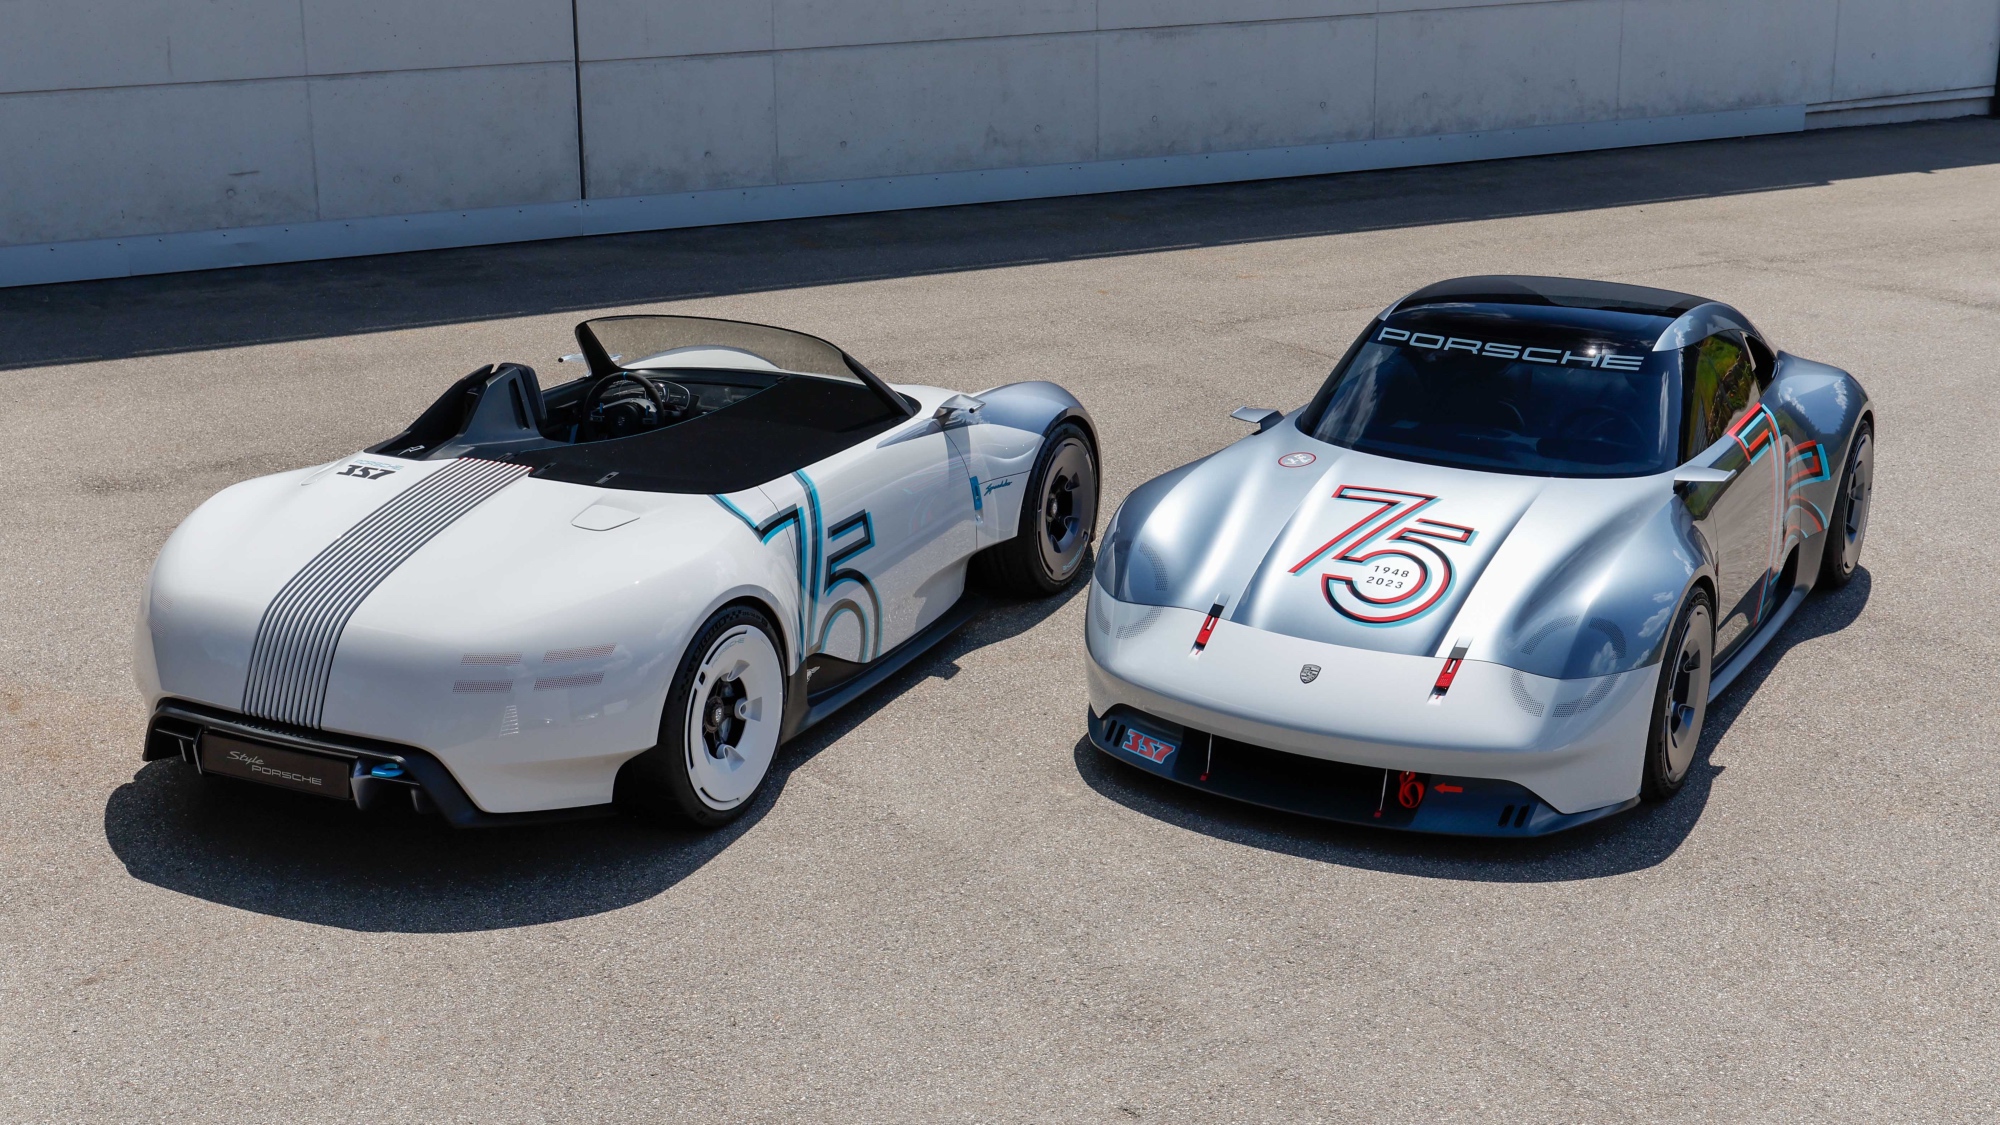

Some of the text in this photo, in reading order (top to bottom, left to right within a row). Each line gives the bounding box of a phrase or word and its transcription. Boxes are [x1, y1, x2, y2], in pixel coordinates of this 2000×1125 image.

[1378, 327, 1644, 371] PORSCHE
[336, 464, 397, 480] 357
[1287, 484, 1480, 629] 75
[1374, 565, 1410, 578] 1948
[1366, 576, 1404, 589] 2023
[1122, 728, 1176, 765] 357
[226, 750, 265, 765] Style
[251, 764, 322, 786] PORSCHE
